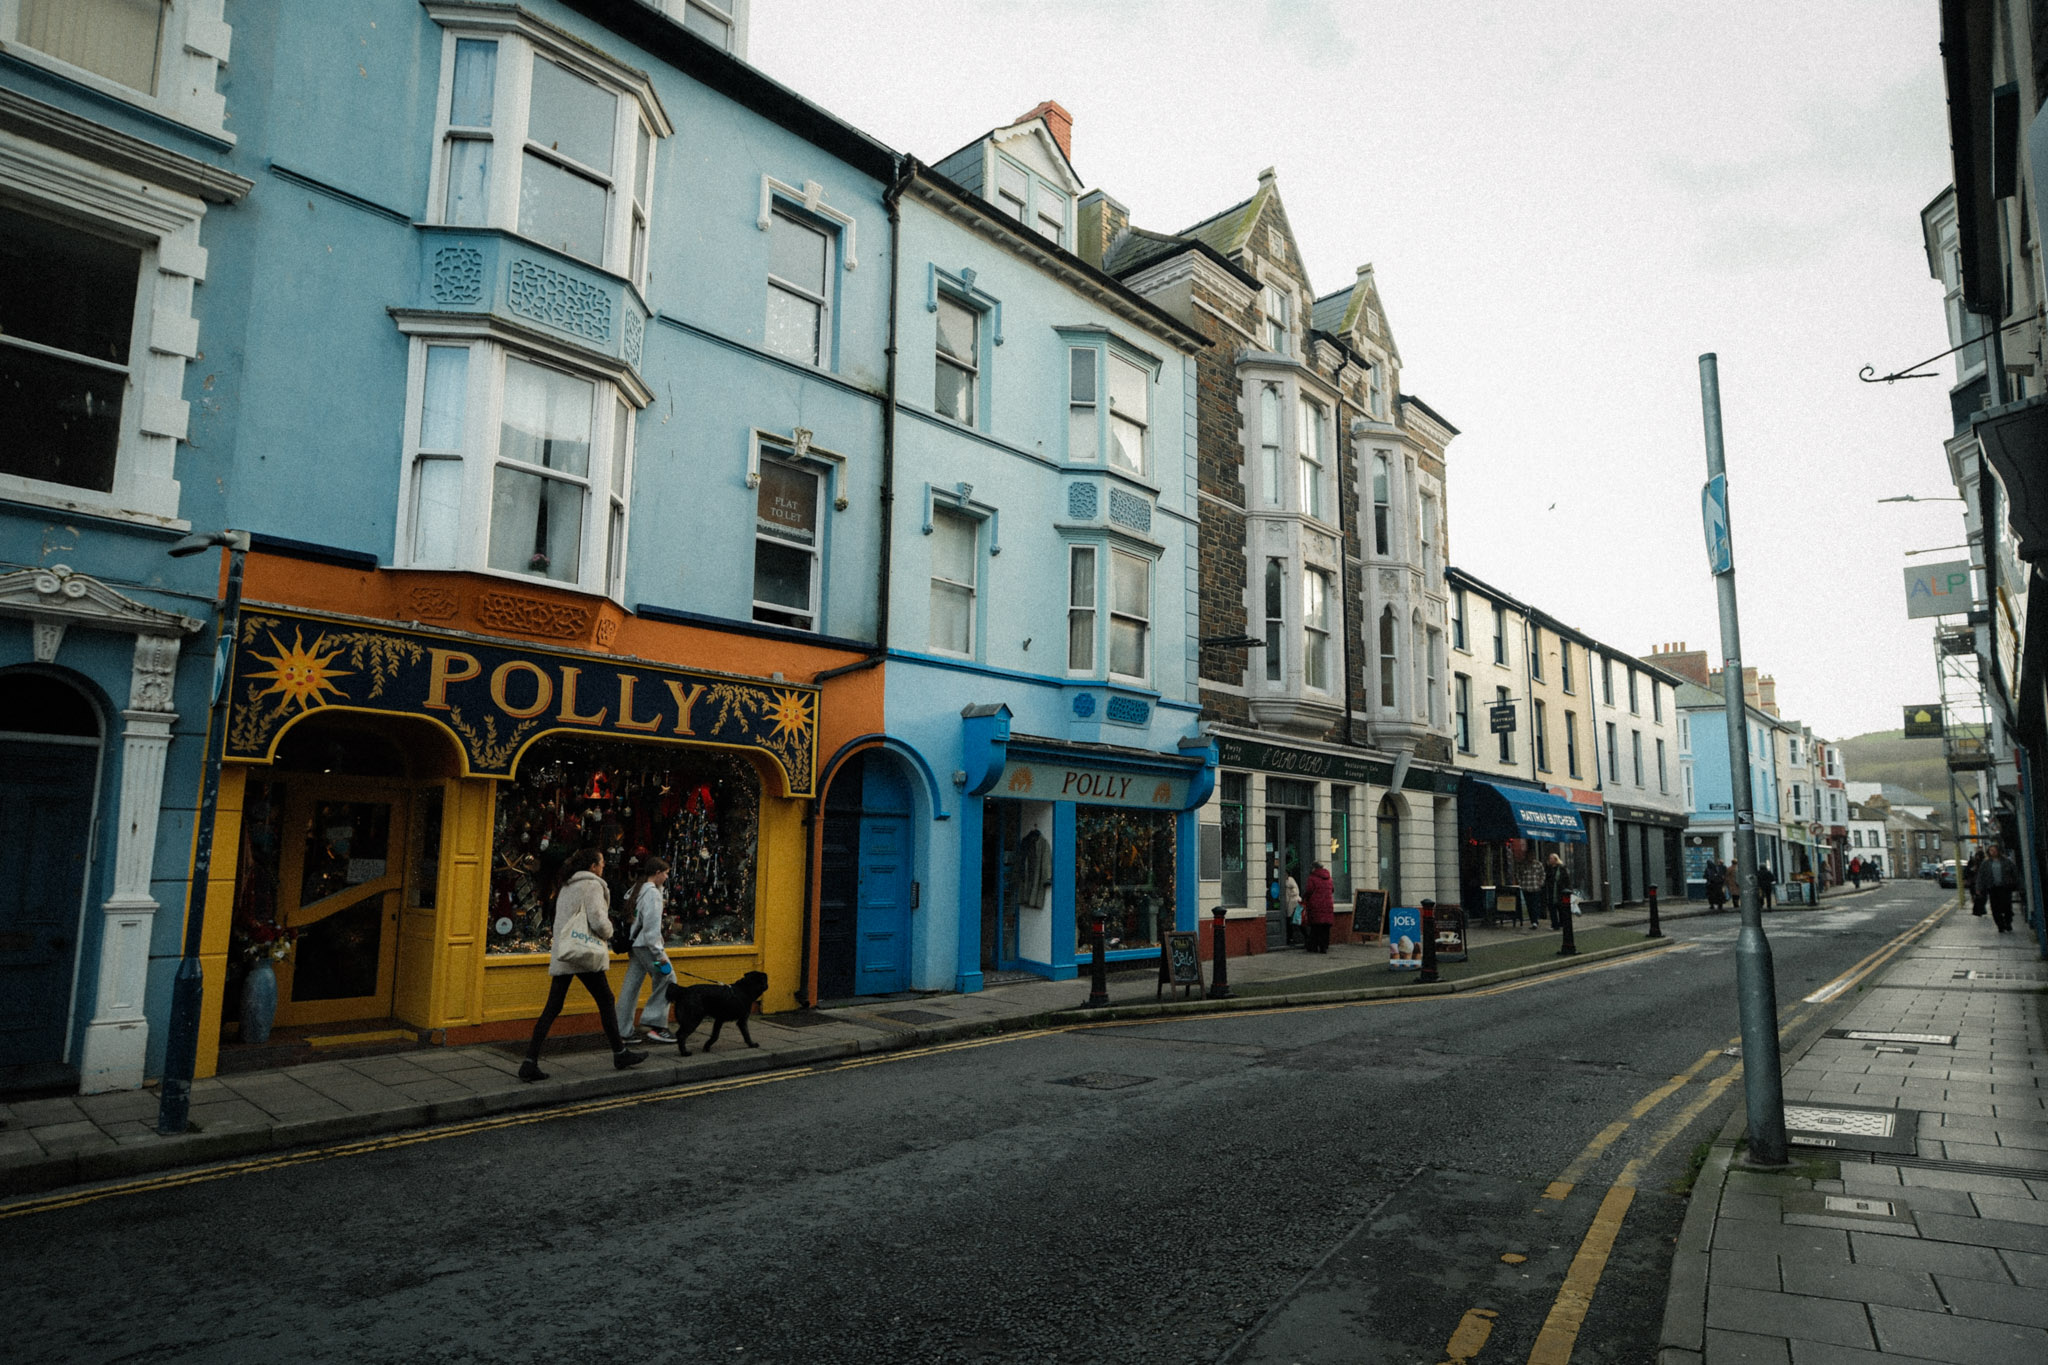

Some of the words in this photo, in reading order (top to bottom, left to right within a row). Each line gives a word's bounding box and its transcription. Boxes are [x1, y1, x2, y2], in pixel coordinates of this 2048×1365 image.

[770, 507, 783, 518] TO
[785, 511, 802, 522] LET
[1910, 573, 1967, 598] ALP
[422, 647, 708, 736] POLLY
[1271, 749, 1298, 770] CIAO
[1298, 753, 1323, 774] CIAO
[1061, 771, 1132, 799] POLLY
[1519, 809, 1548, 824] RATTRAY
[1547, 813, 1578, 827] BUTCHERS
